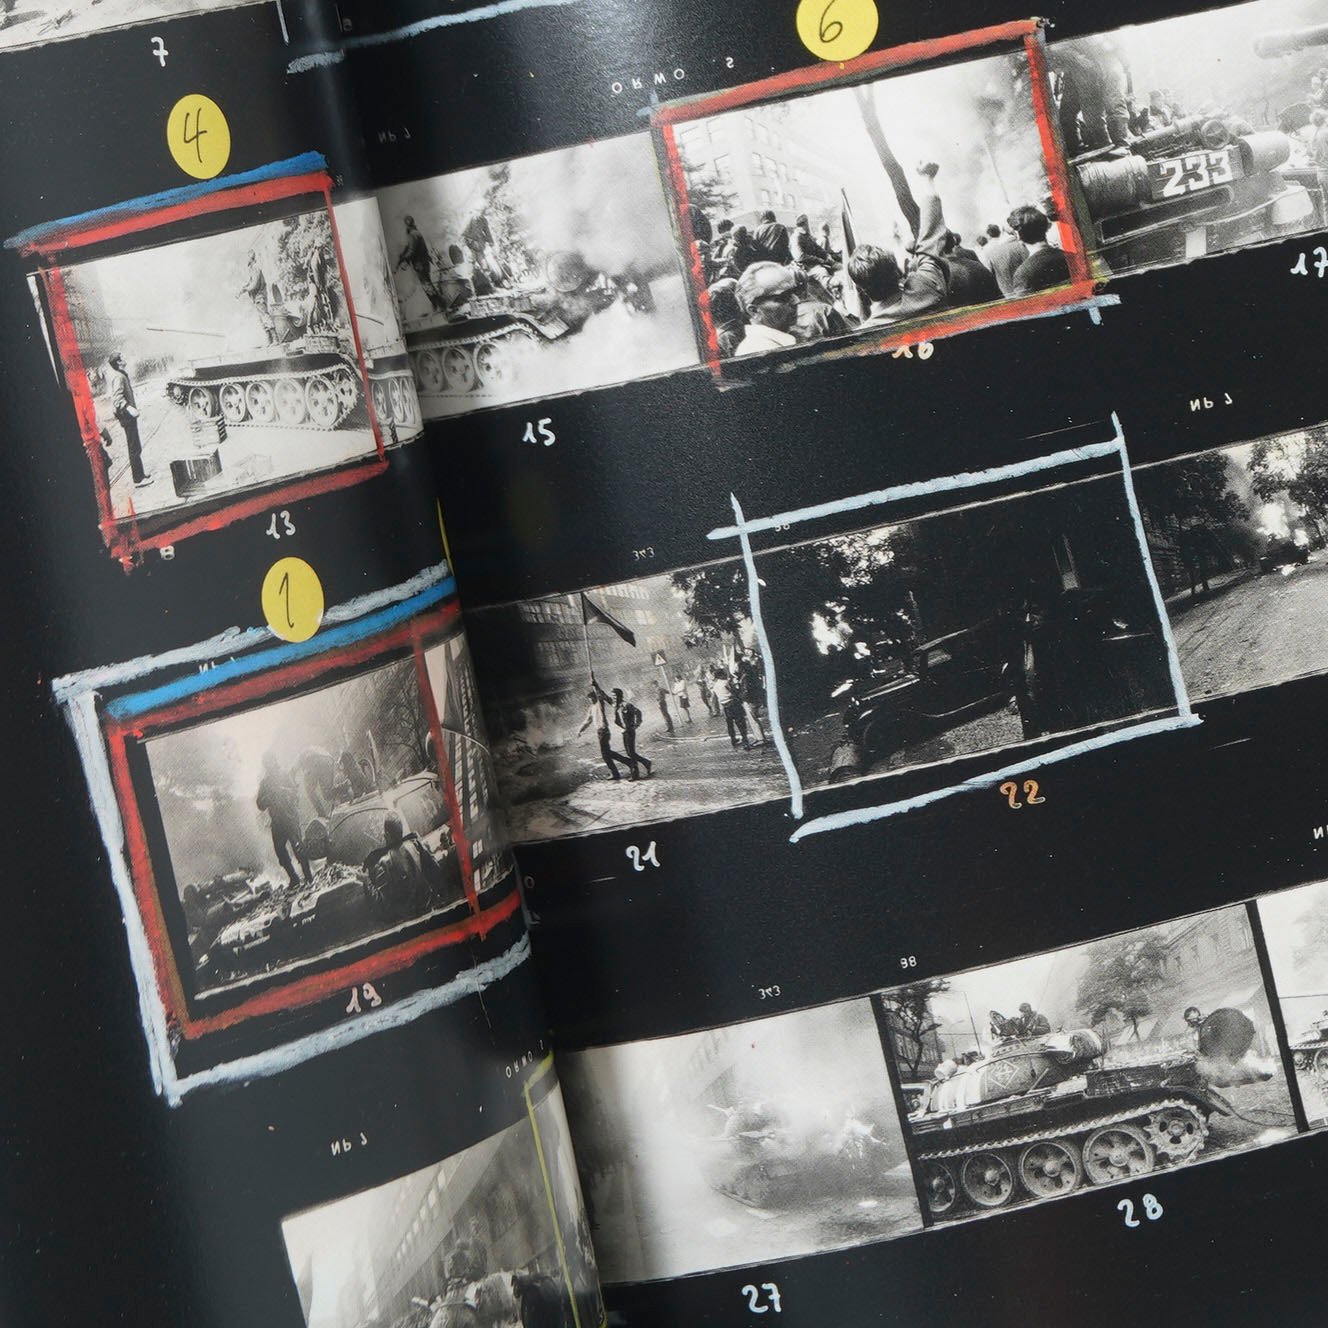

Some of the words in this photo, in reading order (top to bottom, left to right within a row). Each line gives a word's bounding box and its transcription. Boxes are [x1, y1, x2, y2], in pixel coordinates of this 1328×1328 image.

[151, 36, 170, 68] 7
[181, 104, 208, 164] 4
[1160, 150, 1234, 198] 233
[522, 417, 556, 447] 15
[265, 510, 297, 537] 13
[999, 780, 1046, 810] 22
[625, 840, 661, 872] 21
[345, 983, 382, 1014] 19
[1117, 1193, 1164, 1228] 28
[741, 1282, 783, 1315] 27
